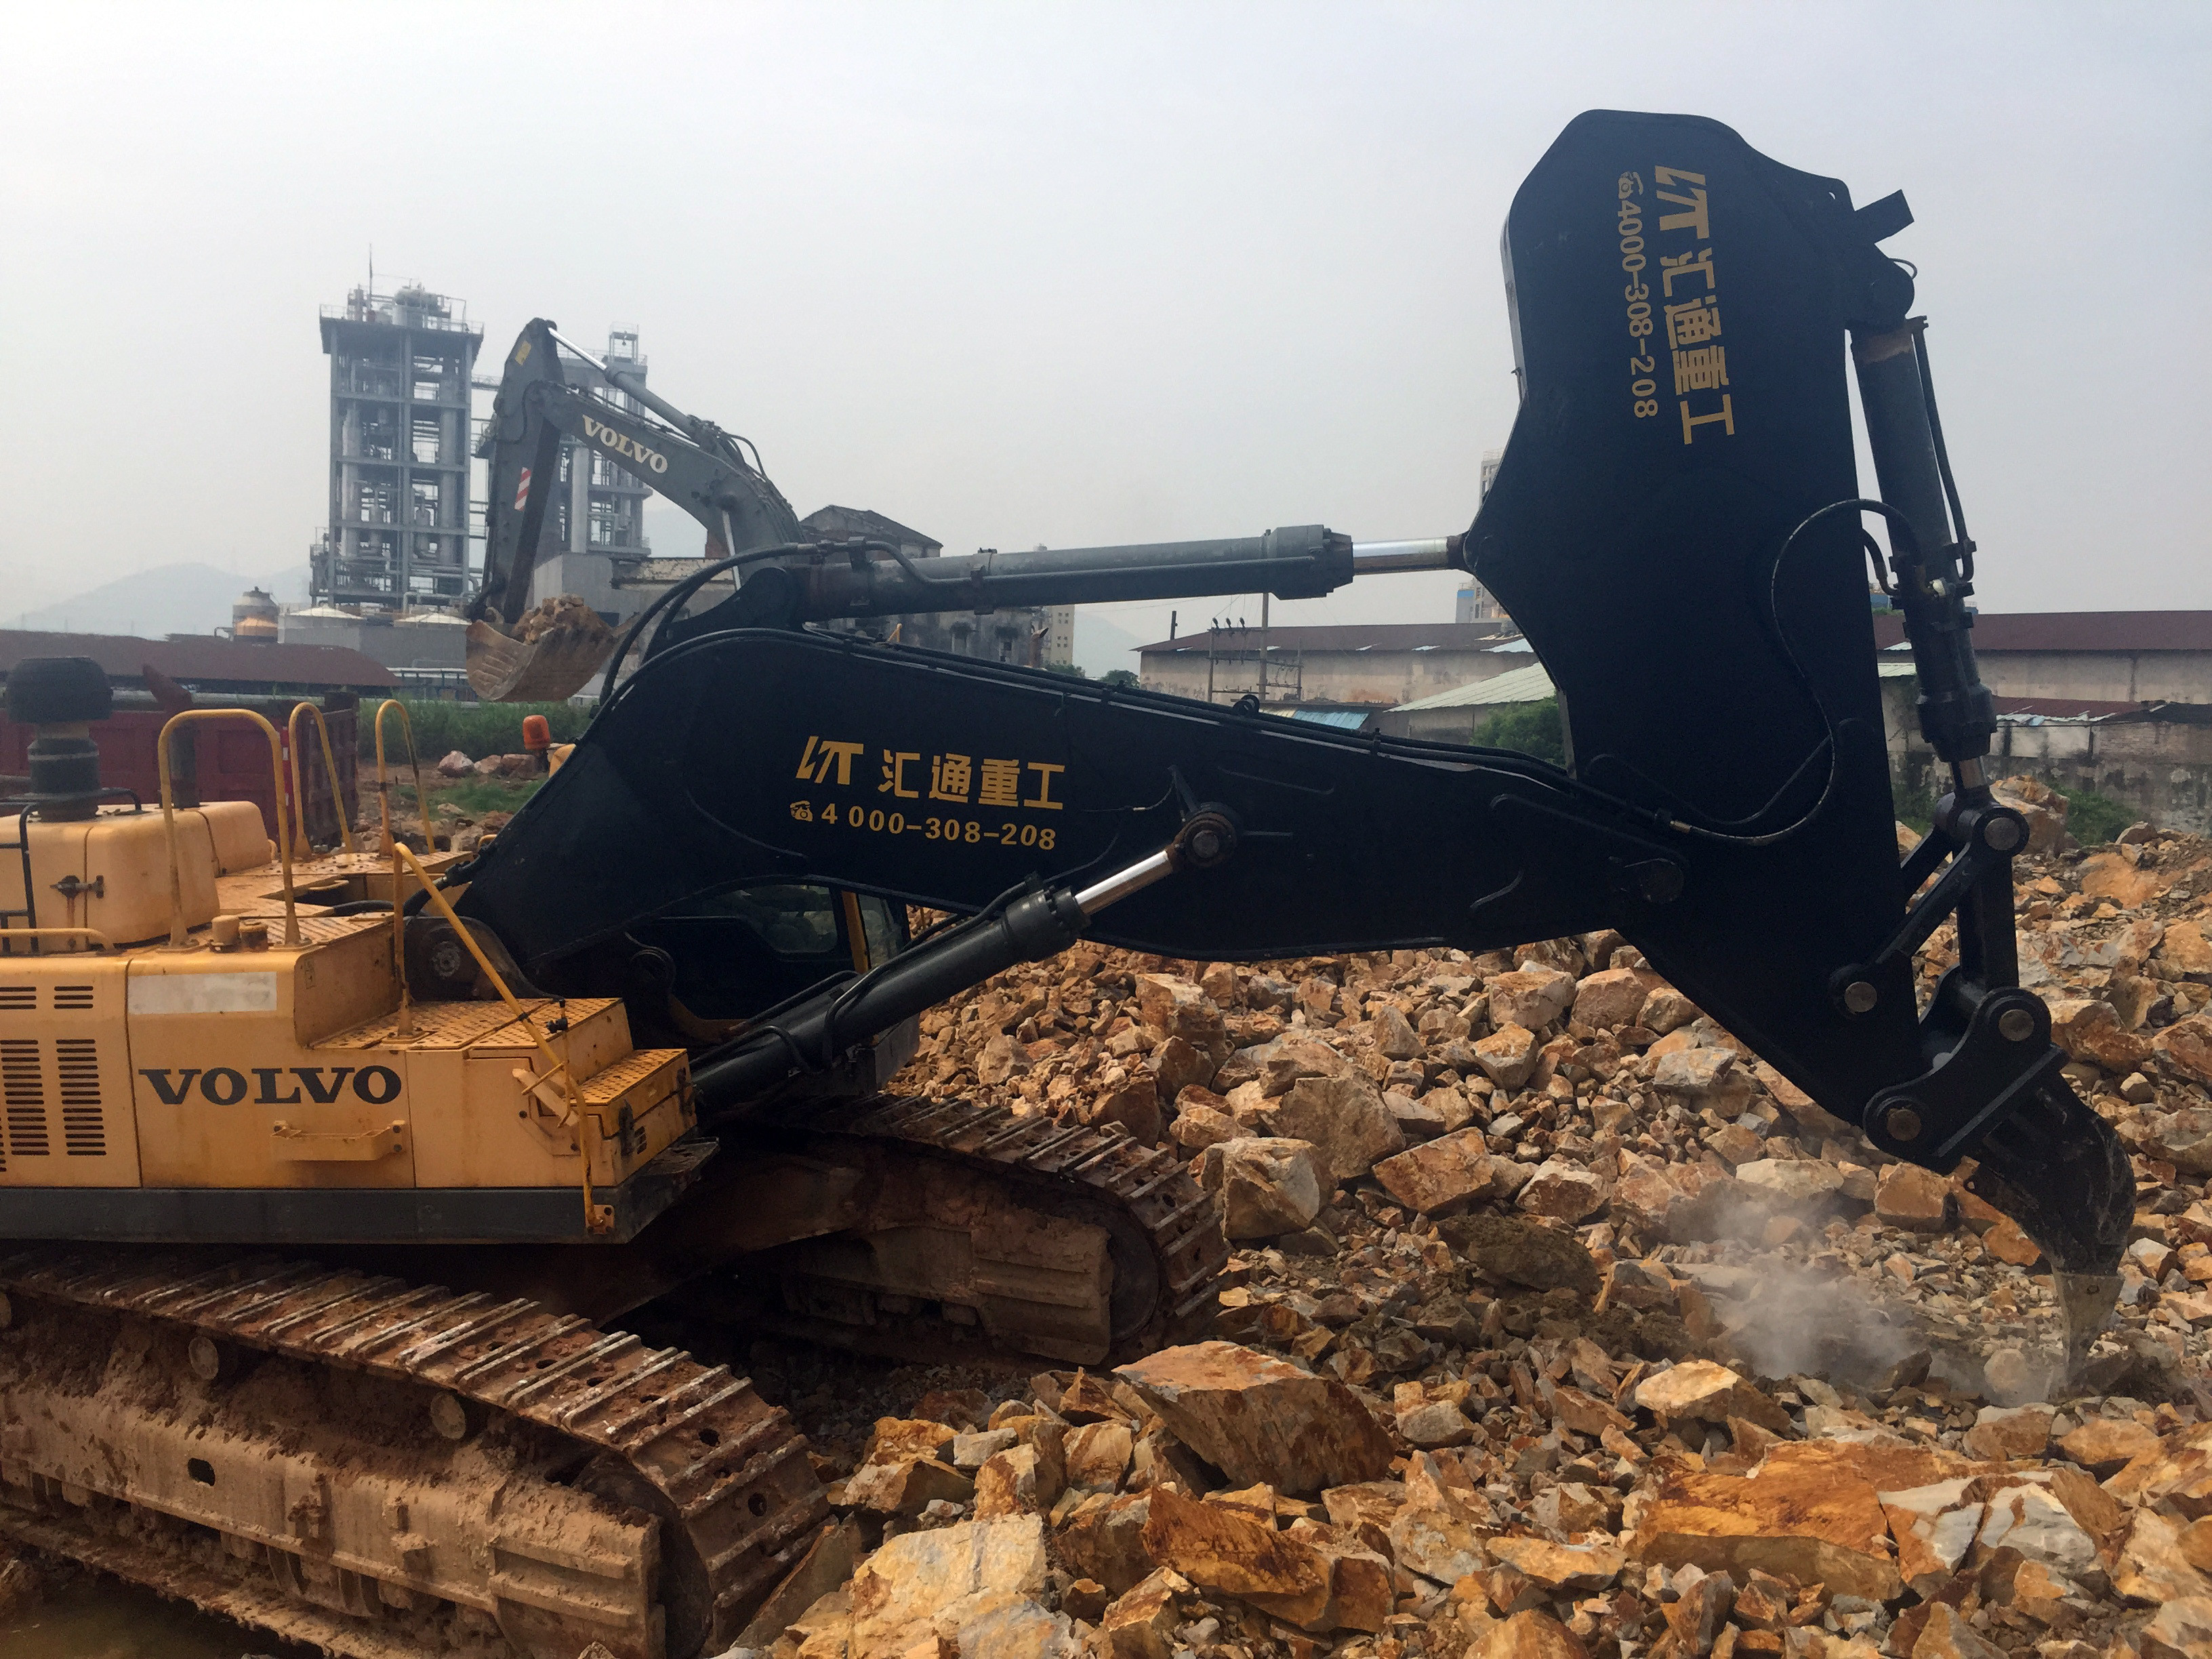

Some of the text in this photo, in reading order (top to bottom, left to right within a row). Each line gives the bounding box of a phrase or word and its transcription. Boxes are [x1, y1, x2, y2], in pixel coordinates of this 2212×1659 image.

[1618, 199, 1658, 418] 4000-308-208
[1660, 247, 1735, 445] 汇通重工
[582, 414, 668, 473] VOLVO
[878, 749, 1065, 810] 汇通重工
[138, 1065, 401, 1105] VOLVO
